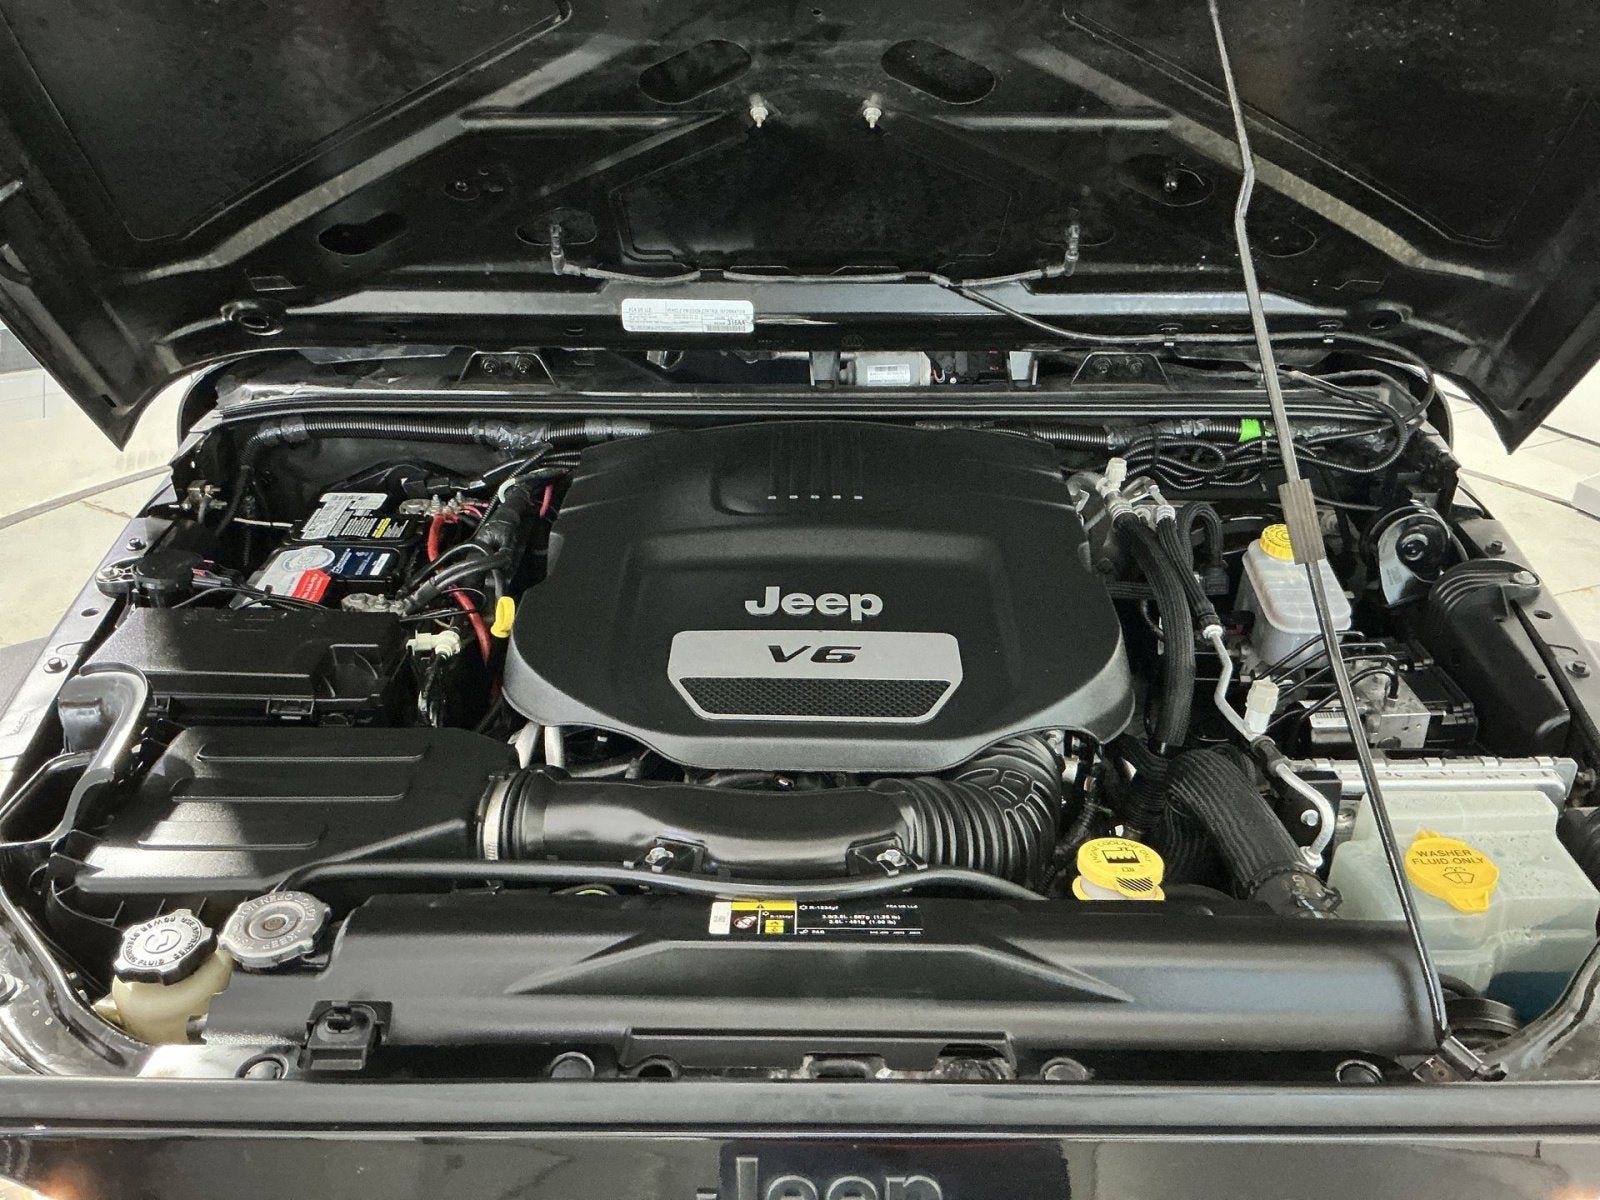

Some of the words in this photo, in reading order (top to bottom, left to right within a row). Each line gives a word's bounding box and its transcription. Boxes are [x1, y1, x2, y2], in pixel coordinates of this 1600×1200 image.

[744, 586, 883, 623] Jeep
[768, 645, 862, 663] V6
[1416, 849, 1473, 857] WASHER
[1452, 857, 1484, 865] ONLY
[140, 916, 177, 933] POWER
